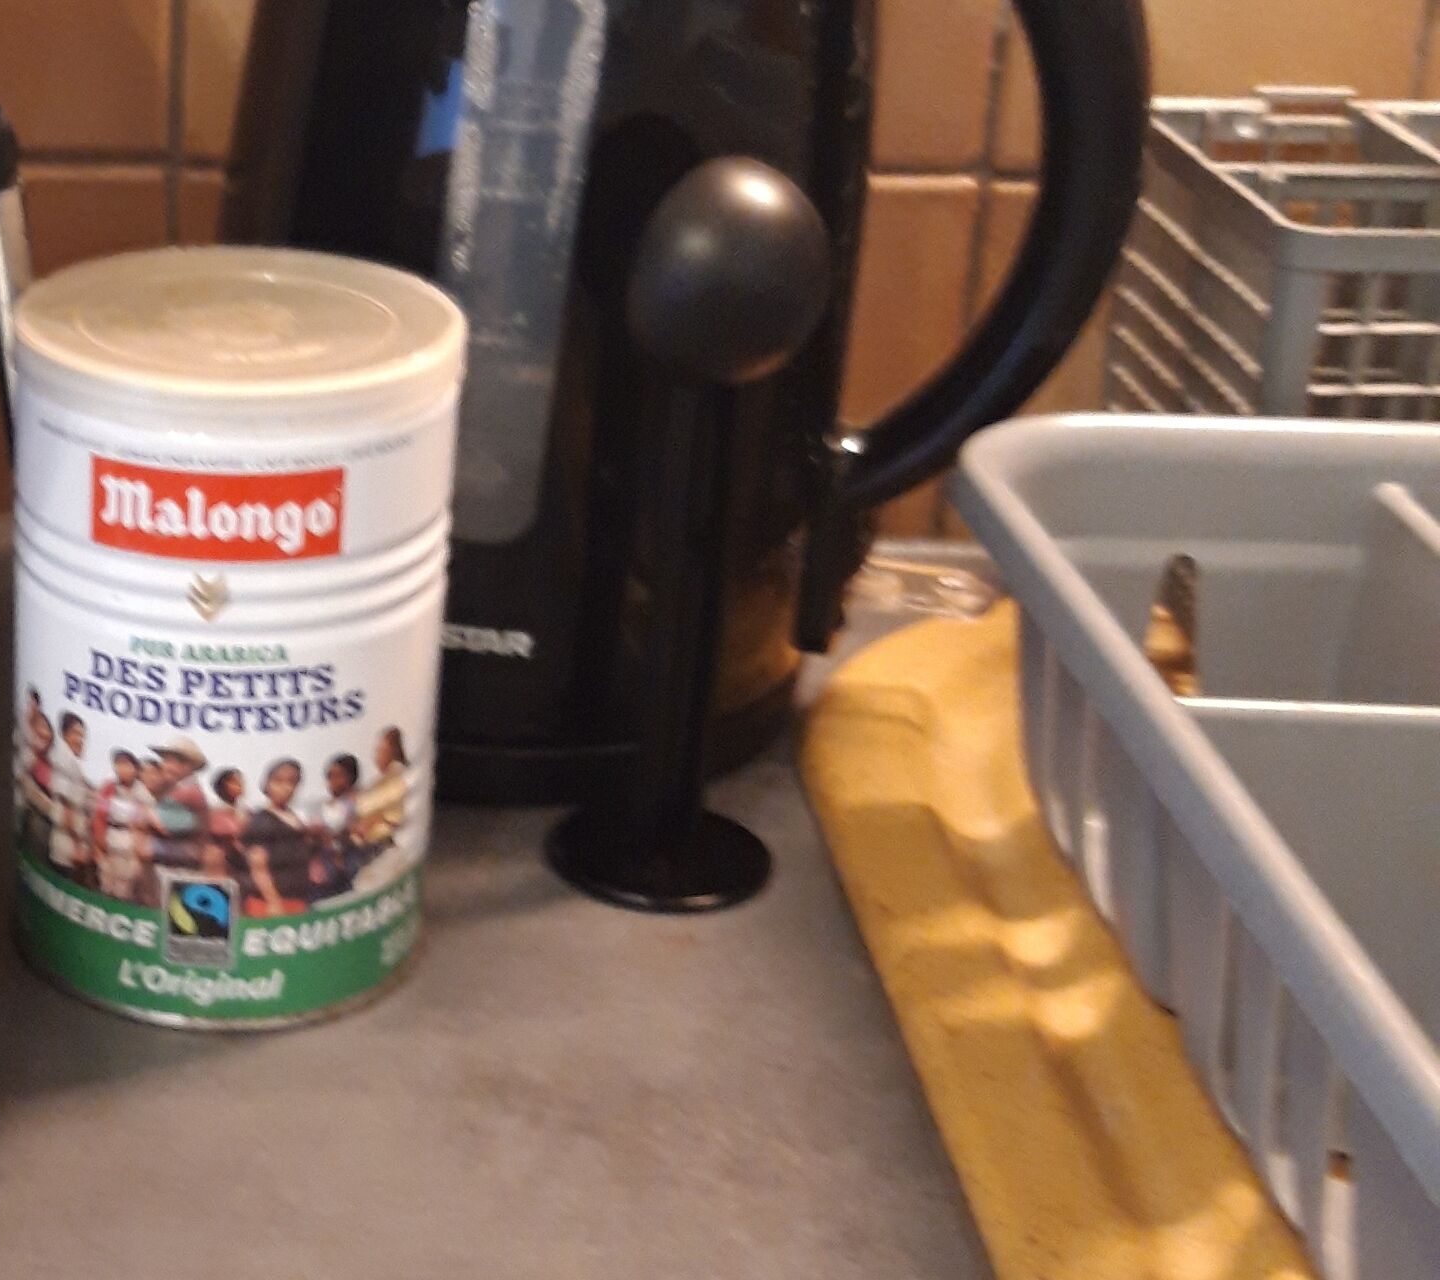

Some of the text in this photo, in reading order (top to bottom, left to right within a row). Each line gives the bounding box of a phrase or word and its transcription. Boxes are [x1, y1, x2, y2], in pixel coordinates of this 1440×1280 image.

[99, 473, 338, 555] Malongo
[62, 670, 368, 732] PRODUCTEURS
[89, 647, 335, 700] DES PETITS
